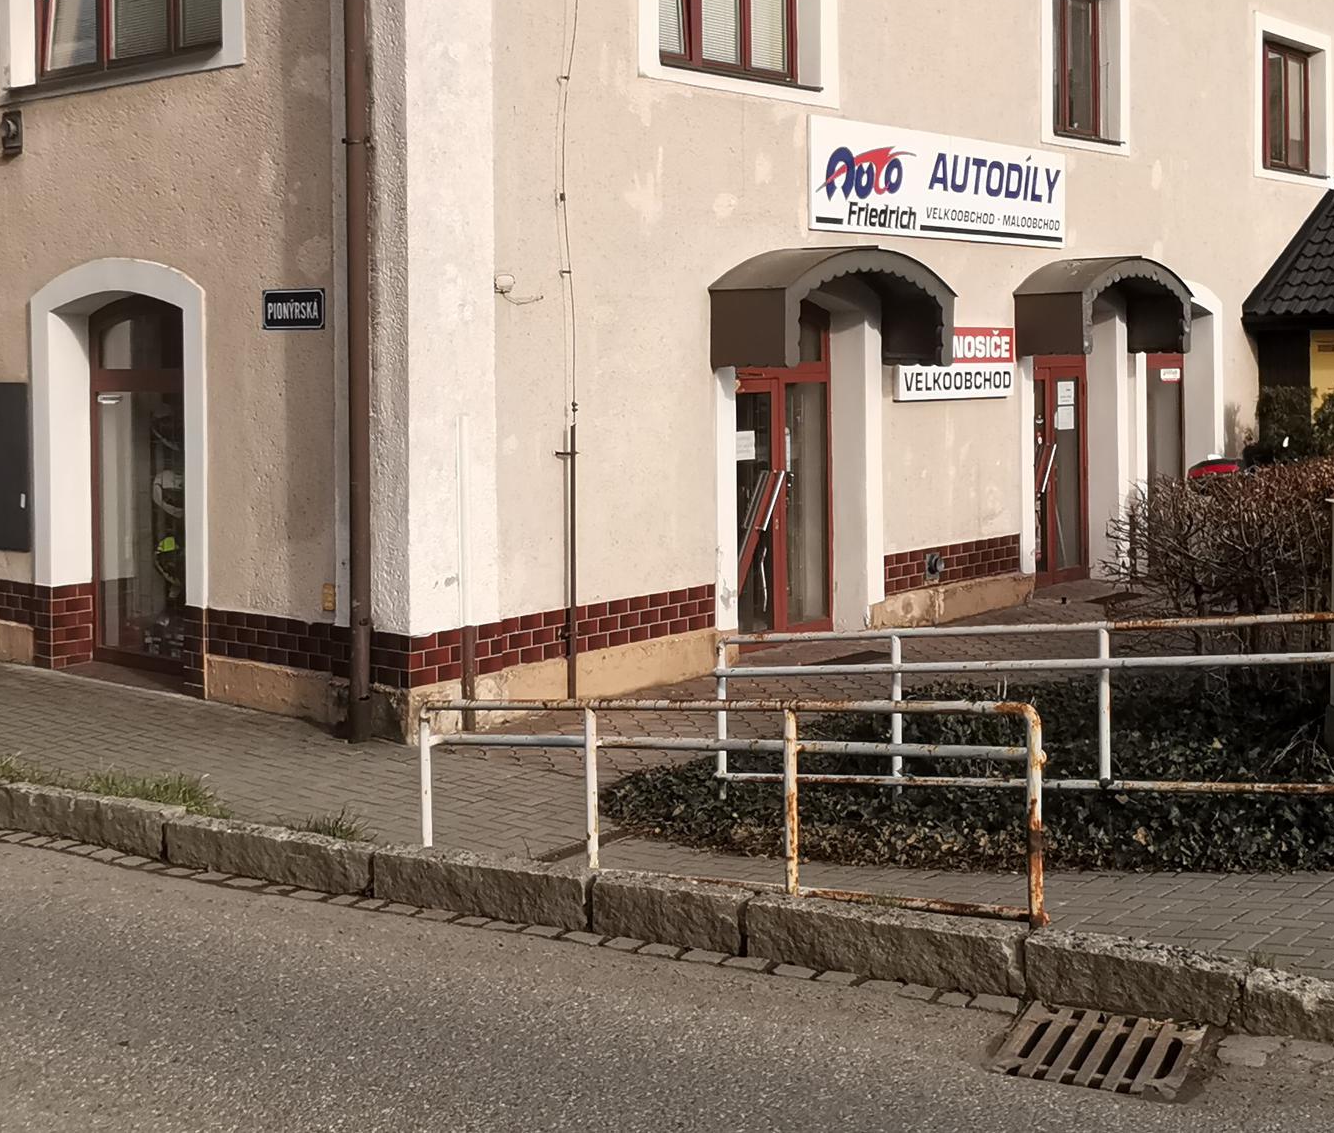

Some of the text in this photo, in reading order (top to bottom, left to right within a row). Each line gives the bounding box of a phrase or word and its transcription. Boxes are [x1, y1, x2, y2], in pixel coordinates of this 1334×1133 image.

[928, 154, 1061, 204] AUTODÍLY
[847, 201, 917, 230] Friedrich
[926, 207, 995, 226] VELKOOBCHOD
[1002, 214, 1060, 232] MALOOBCHOD
[267, 298, 319, 320] PIONÝRSKÁ
[953, 329, 1010, 359] NOSIČE
[904, 371, 1012, 392] VELKOOBCHOD
